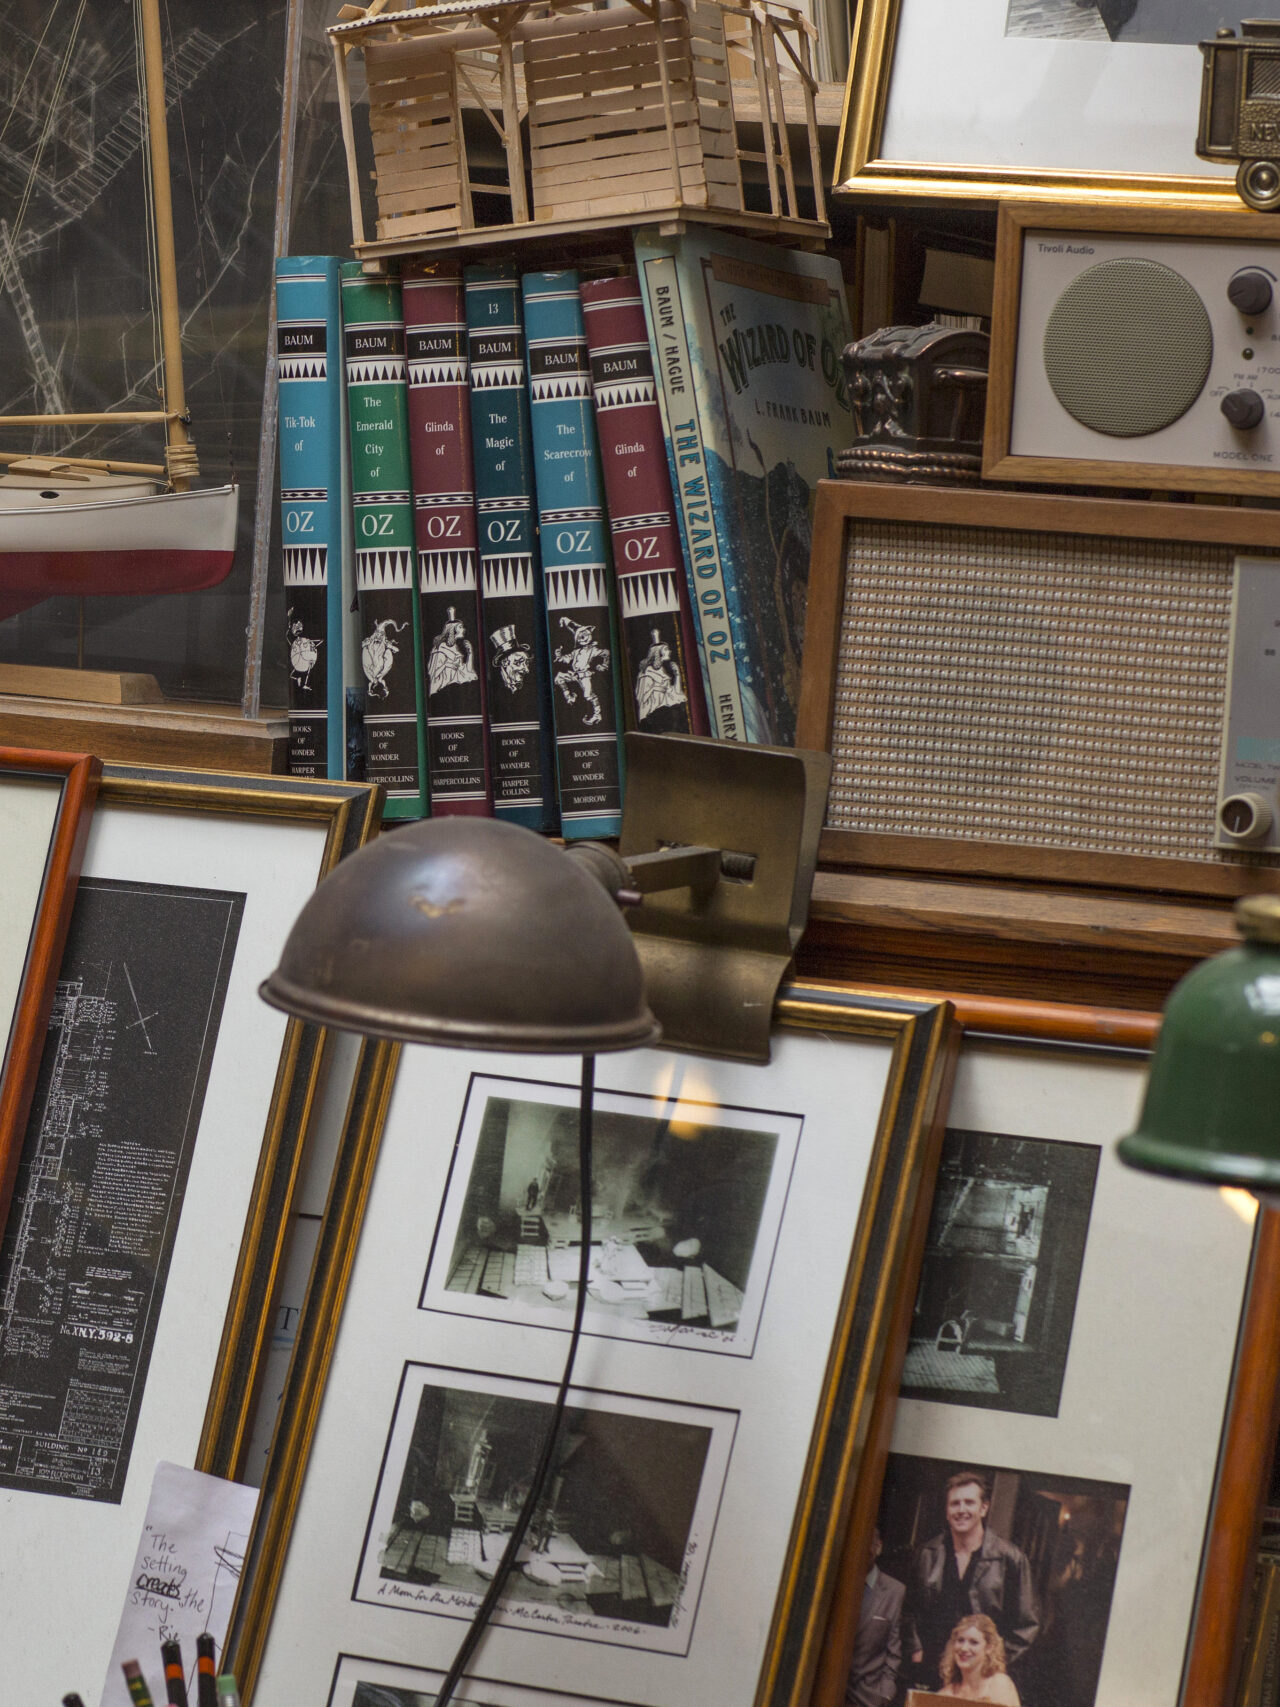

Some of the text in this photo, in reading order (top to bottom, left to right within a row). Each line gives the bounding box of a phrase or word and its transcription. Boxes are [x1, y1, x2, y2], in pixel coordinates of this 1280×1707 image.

[1251, 122, 1280, 141] NE
[1038, 243, 1095, 255] Tivoli Audio
[488, 303, 499, 315] 13
[720, 303, 737, 326] THE
[284, 334, 313, 346] BAUM
[355, 337, 387, 349] BAUM
[419, 339, 452, 351] BAUM
[655, 286, 675, 328] BAUM
[665, 346, 685, 395] HAGUE
[479, 342, 512, 354] BAUM
[545, 353, 578, 366] BAUM
[719, 323, 790, 395] WIZARD
[792, 328, 816, 371] OF
[603, 359, 637, 373] BAUM
[364, 397, 382, 407] The
[489, 413, 508, 424] The
[766, 401, 799, 424] FRANK
[801, 408, 832, 428] BAUM
[285, 416, 316, 428] Tik-Tok
[356, 419, 393, 431] Emerald
[425, 421, 454, 433] Glinda
[556, 424, 576, 435] The
[295, 441, 304, 452] of
[365, 443, 384, 456] City
[485, 437, 515, 450] Magic
[615, 442, 645, 456] Glinda
[435, 444, 446, 456] of
[544, 447, 593, 461] Scarecrow
[1213, 450, 1273, 463] MODEL ONE
[370, 467, 380, 478] of
[495, 461, 505, 472] of
[627, 466, 637, 478] of
[564, 471, 574, 482] of
[286, 511, 315, 533] OZ
[361, 514, 395, 536] OZ
[427, 516, 462, 539] OZ
[487, 519, 522, 543] OZ
[556, 530, 592, 554] OZ
[674, 418, 730, 663] THE WIZARD OF OZ
[624, 536, 661, 562] OZ
[718, 694, 738, 741] HENRY
[292, 725, 312, 733] BOOKS
[372, 730, 395, 738] BOOKS
[297, 737, 306, 745] OF
[441, 732, 465, 740] BOOKS
[502, 738, 526, 746] BOOKS
[291, 749, 315, 757] WONDER
[371, 753, 399, 761] WONDER
[574, 749, 600, 758] BOOKS
[439, 755, 469, 764] WONDER
[500, 761, 531, 770] WONDER
[582, 761, 593, 769] OF
[291, 766, 315, 774] HARPER
[433, 777, 481, 786] HARPERCOLLINS
[502, 779, 529, 787] HARPER
[572, 773, 605, 782] WONDER
[1234, 775, 1277, 785] VOLUME
[502, 787, 531, 796] COLLINS
[573, 795, 607, 804] MORROW
[34, 1440, 70, 1451] BUILDING
[140, 1554, 188, 1580] setting
[184, 1588, 205, 1612] the
